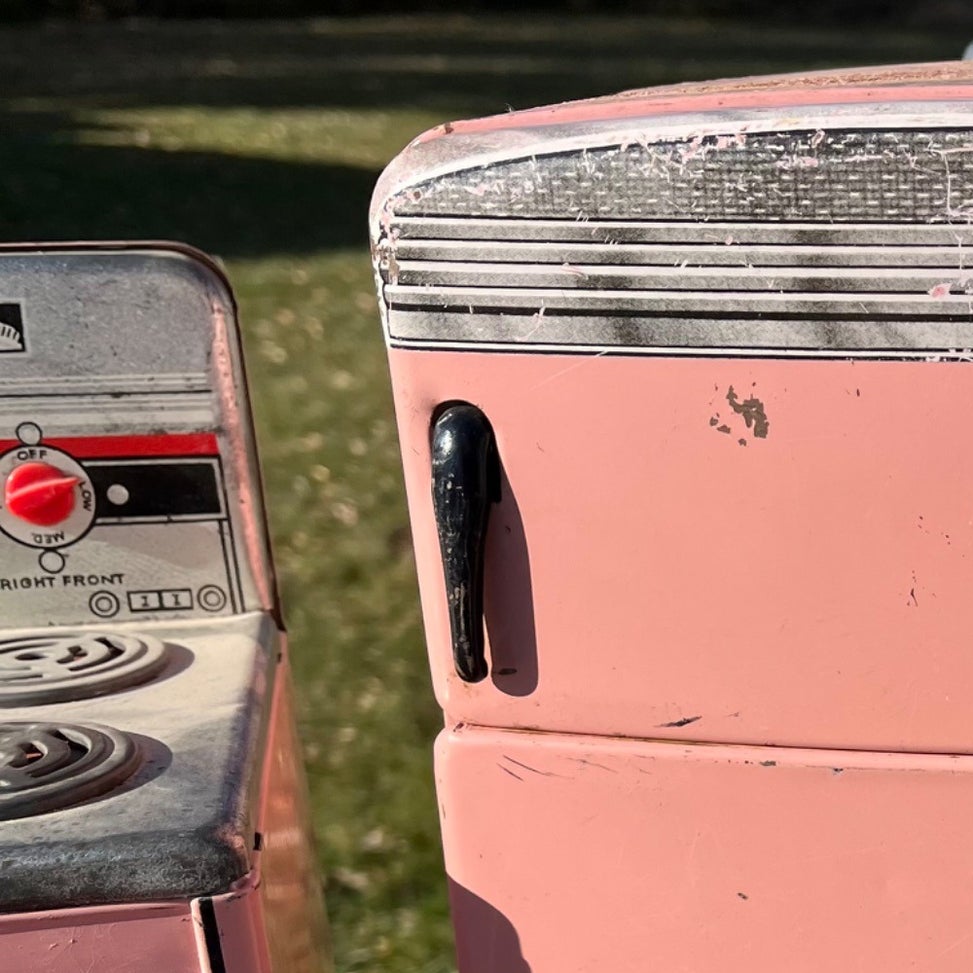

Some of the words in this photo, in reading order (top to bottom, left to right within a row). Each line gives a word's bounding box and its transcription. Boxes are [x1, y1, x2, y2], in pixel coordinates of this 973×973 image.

[17, 449, 47, 461] OFF
[78, 481, 92, 512] LOW
[0, 577, 56, 591] RIGHT
[62, 573, 125, 587] FRONT
